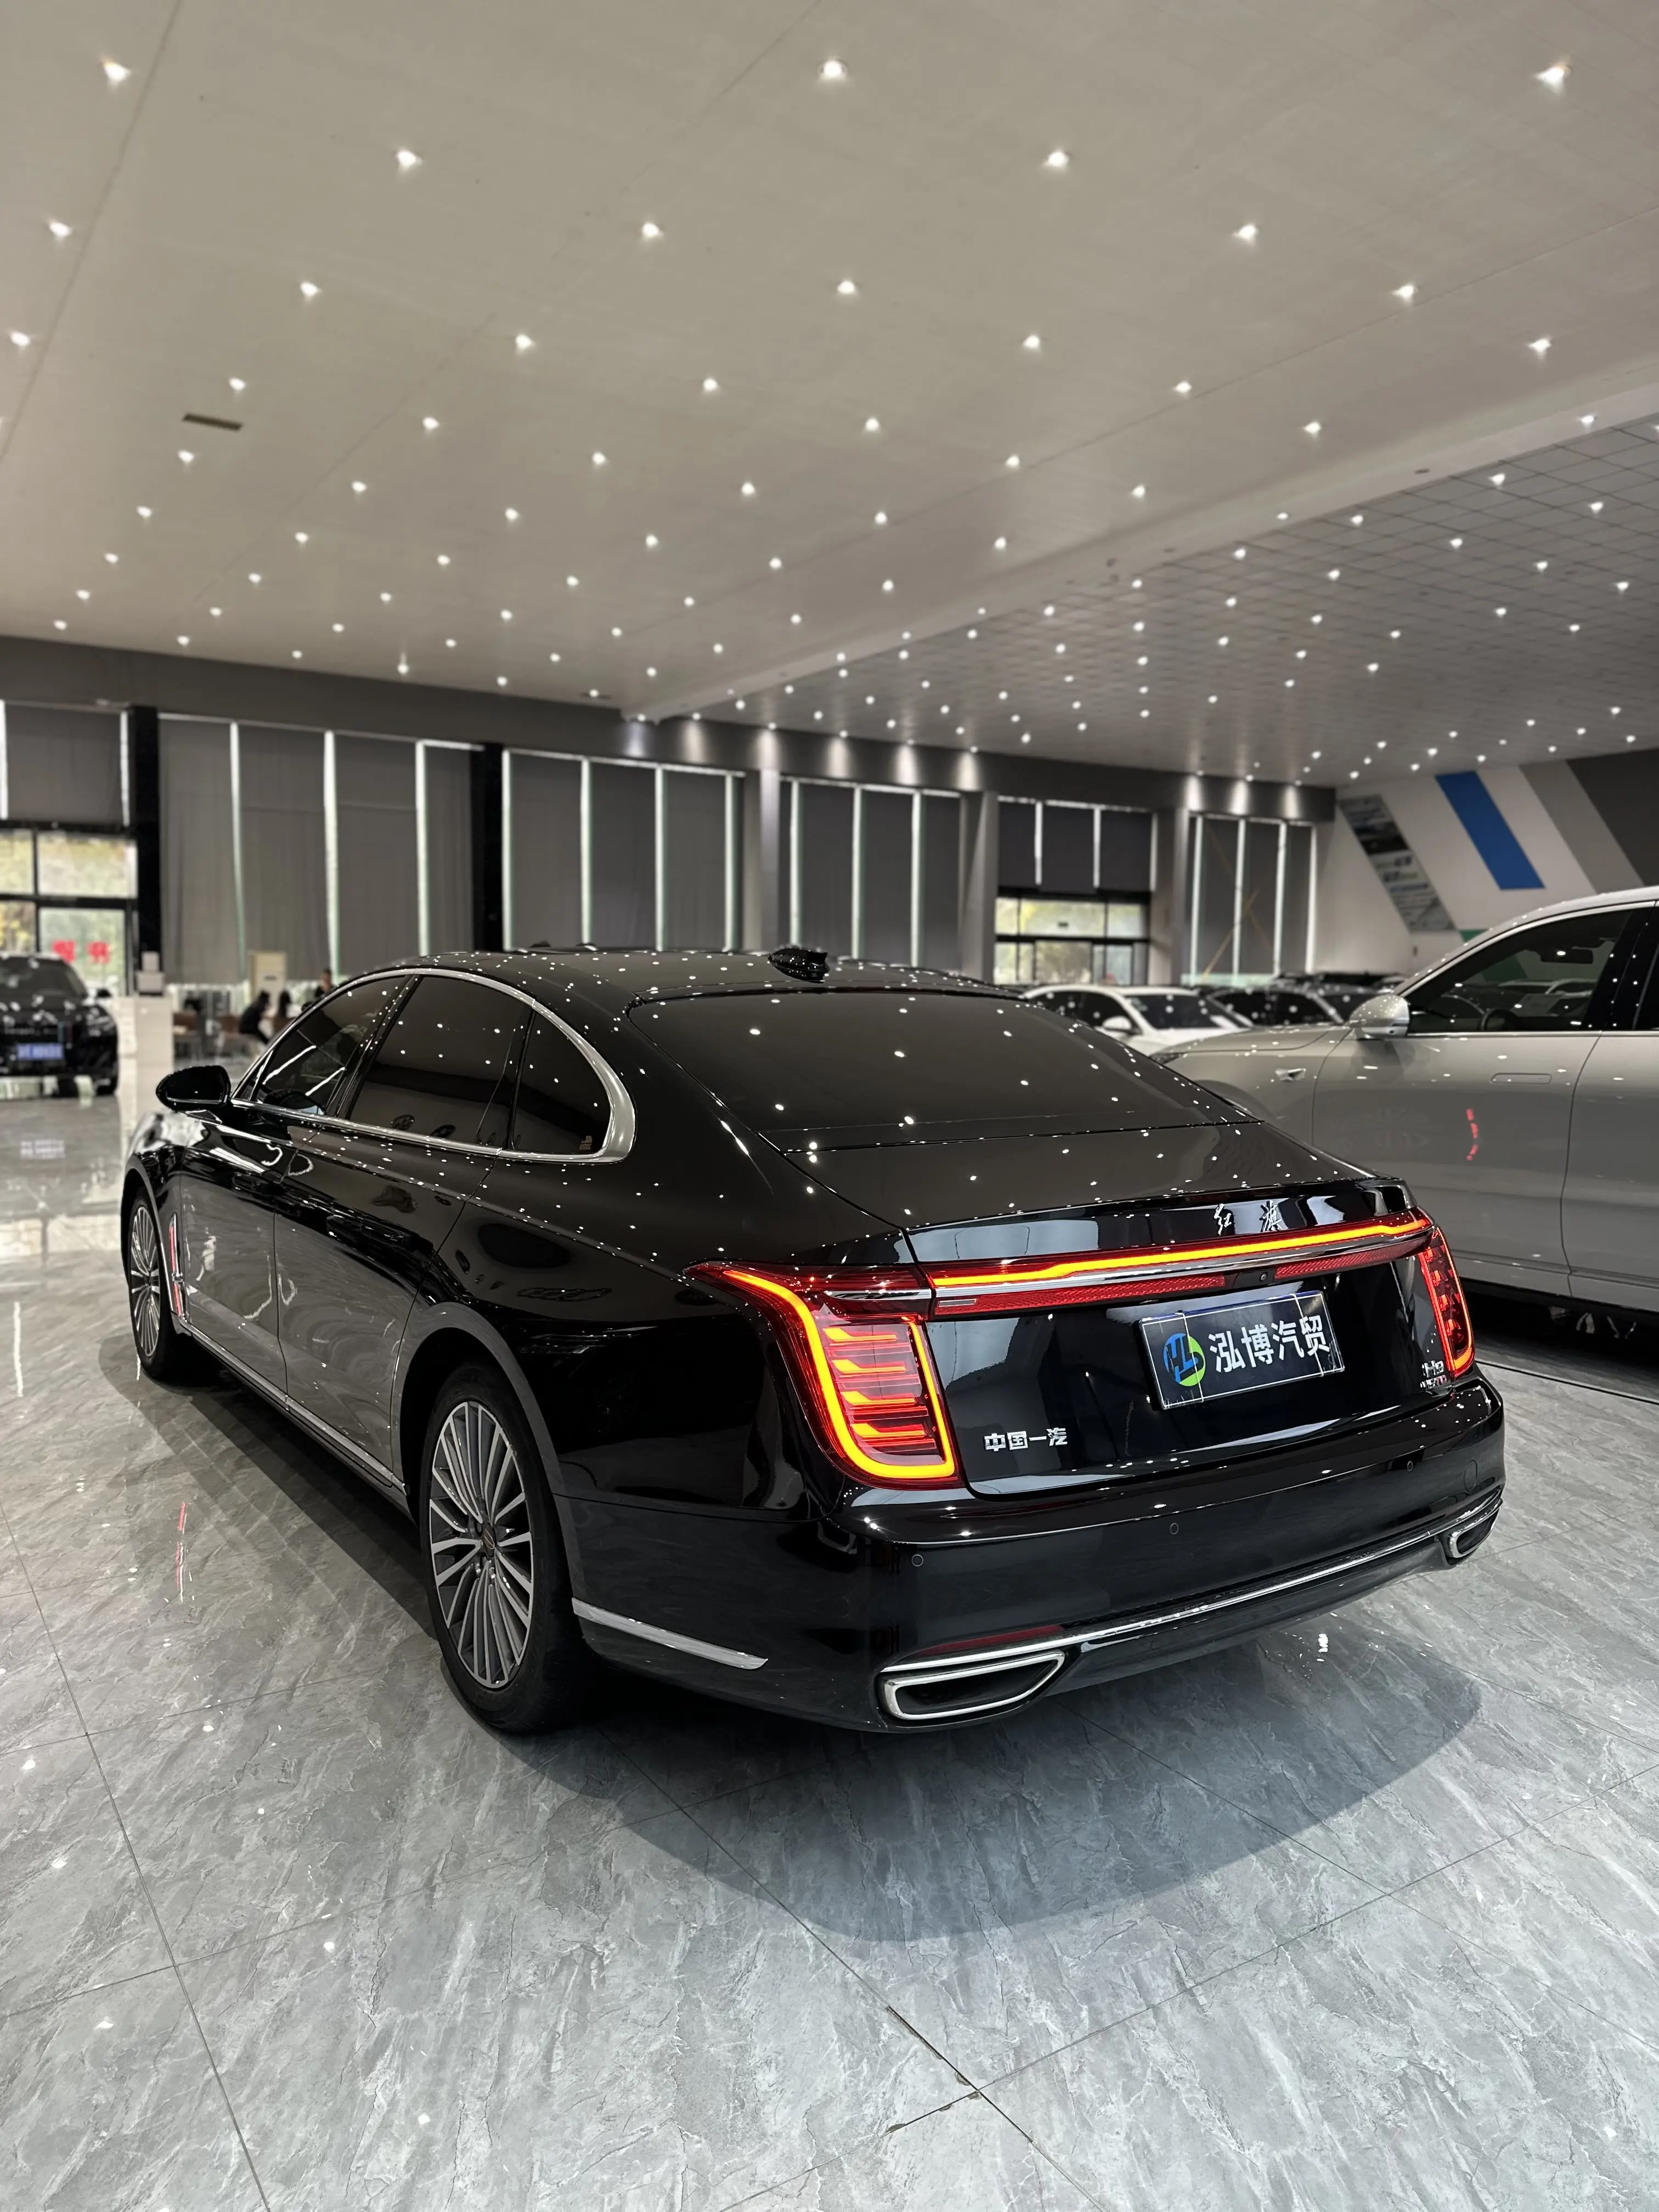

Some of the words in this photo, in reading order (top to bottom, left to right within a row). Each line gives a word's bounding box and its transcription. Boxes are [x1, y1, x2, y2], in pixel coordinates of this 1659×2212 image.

[1214, 1200, 1283, 1236] 红旗
[1208, 1314, 1330, 1373] 泓博汽贸
[984, 1427, 1068, 1452] 中国一汽
